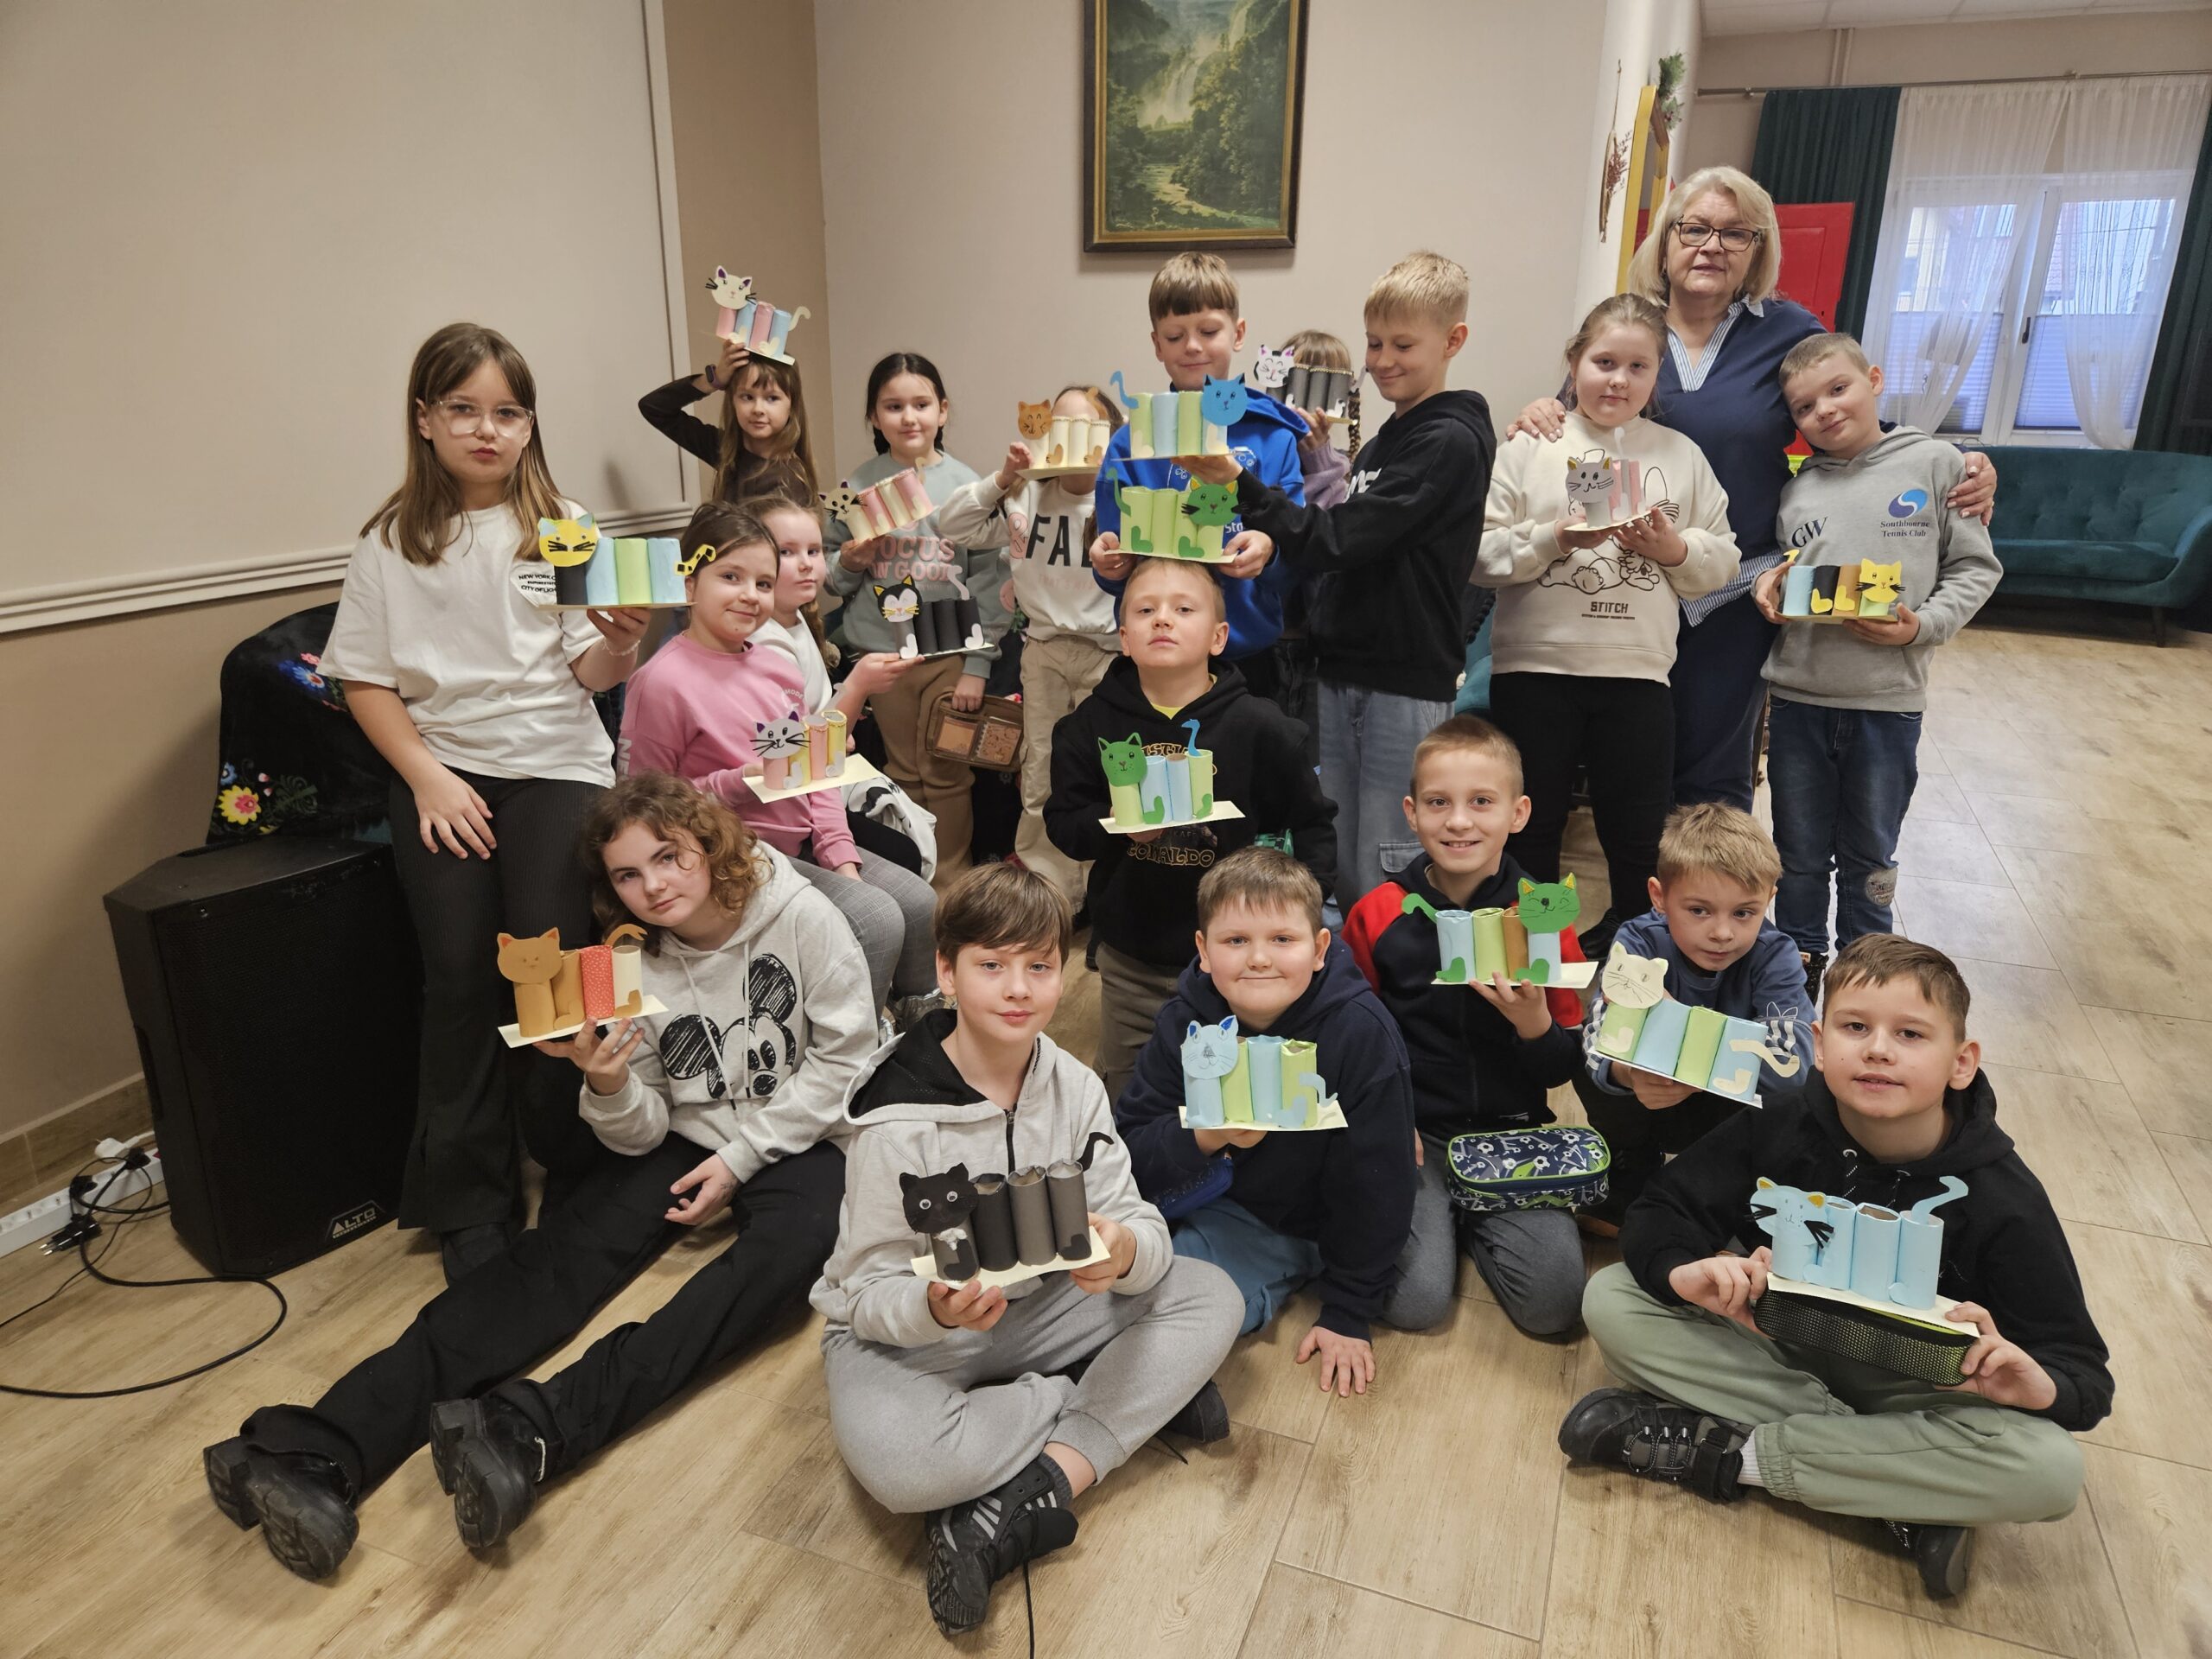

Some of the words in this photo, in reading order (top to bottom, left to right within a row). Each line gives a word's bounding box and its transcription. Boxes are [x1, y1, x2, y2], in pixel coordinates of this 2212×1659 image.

[1791, 517, 1828, 549] GW
[1880, 520, 1930, 529] Southbourne
[881, 536, 956, 563] OCUS
[1591, 601, 1629, 613] STITCH
